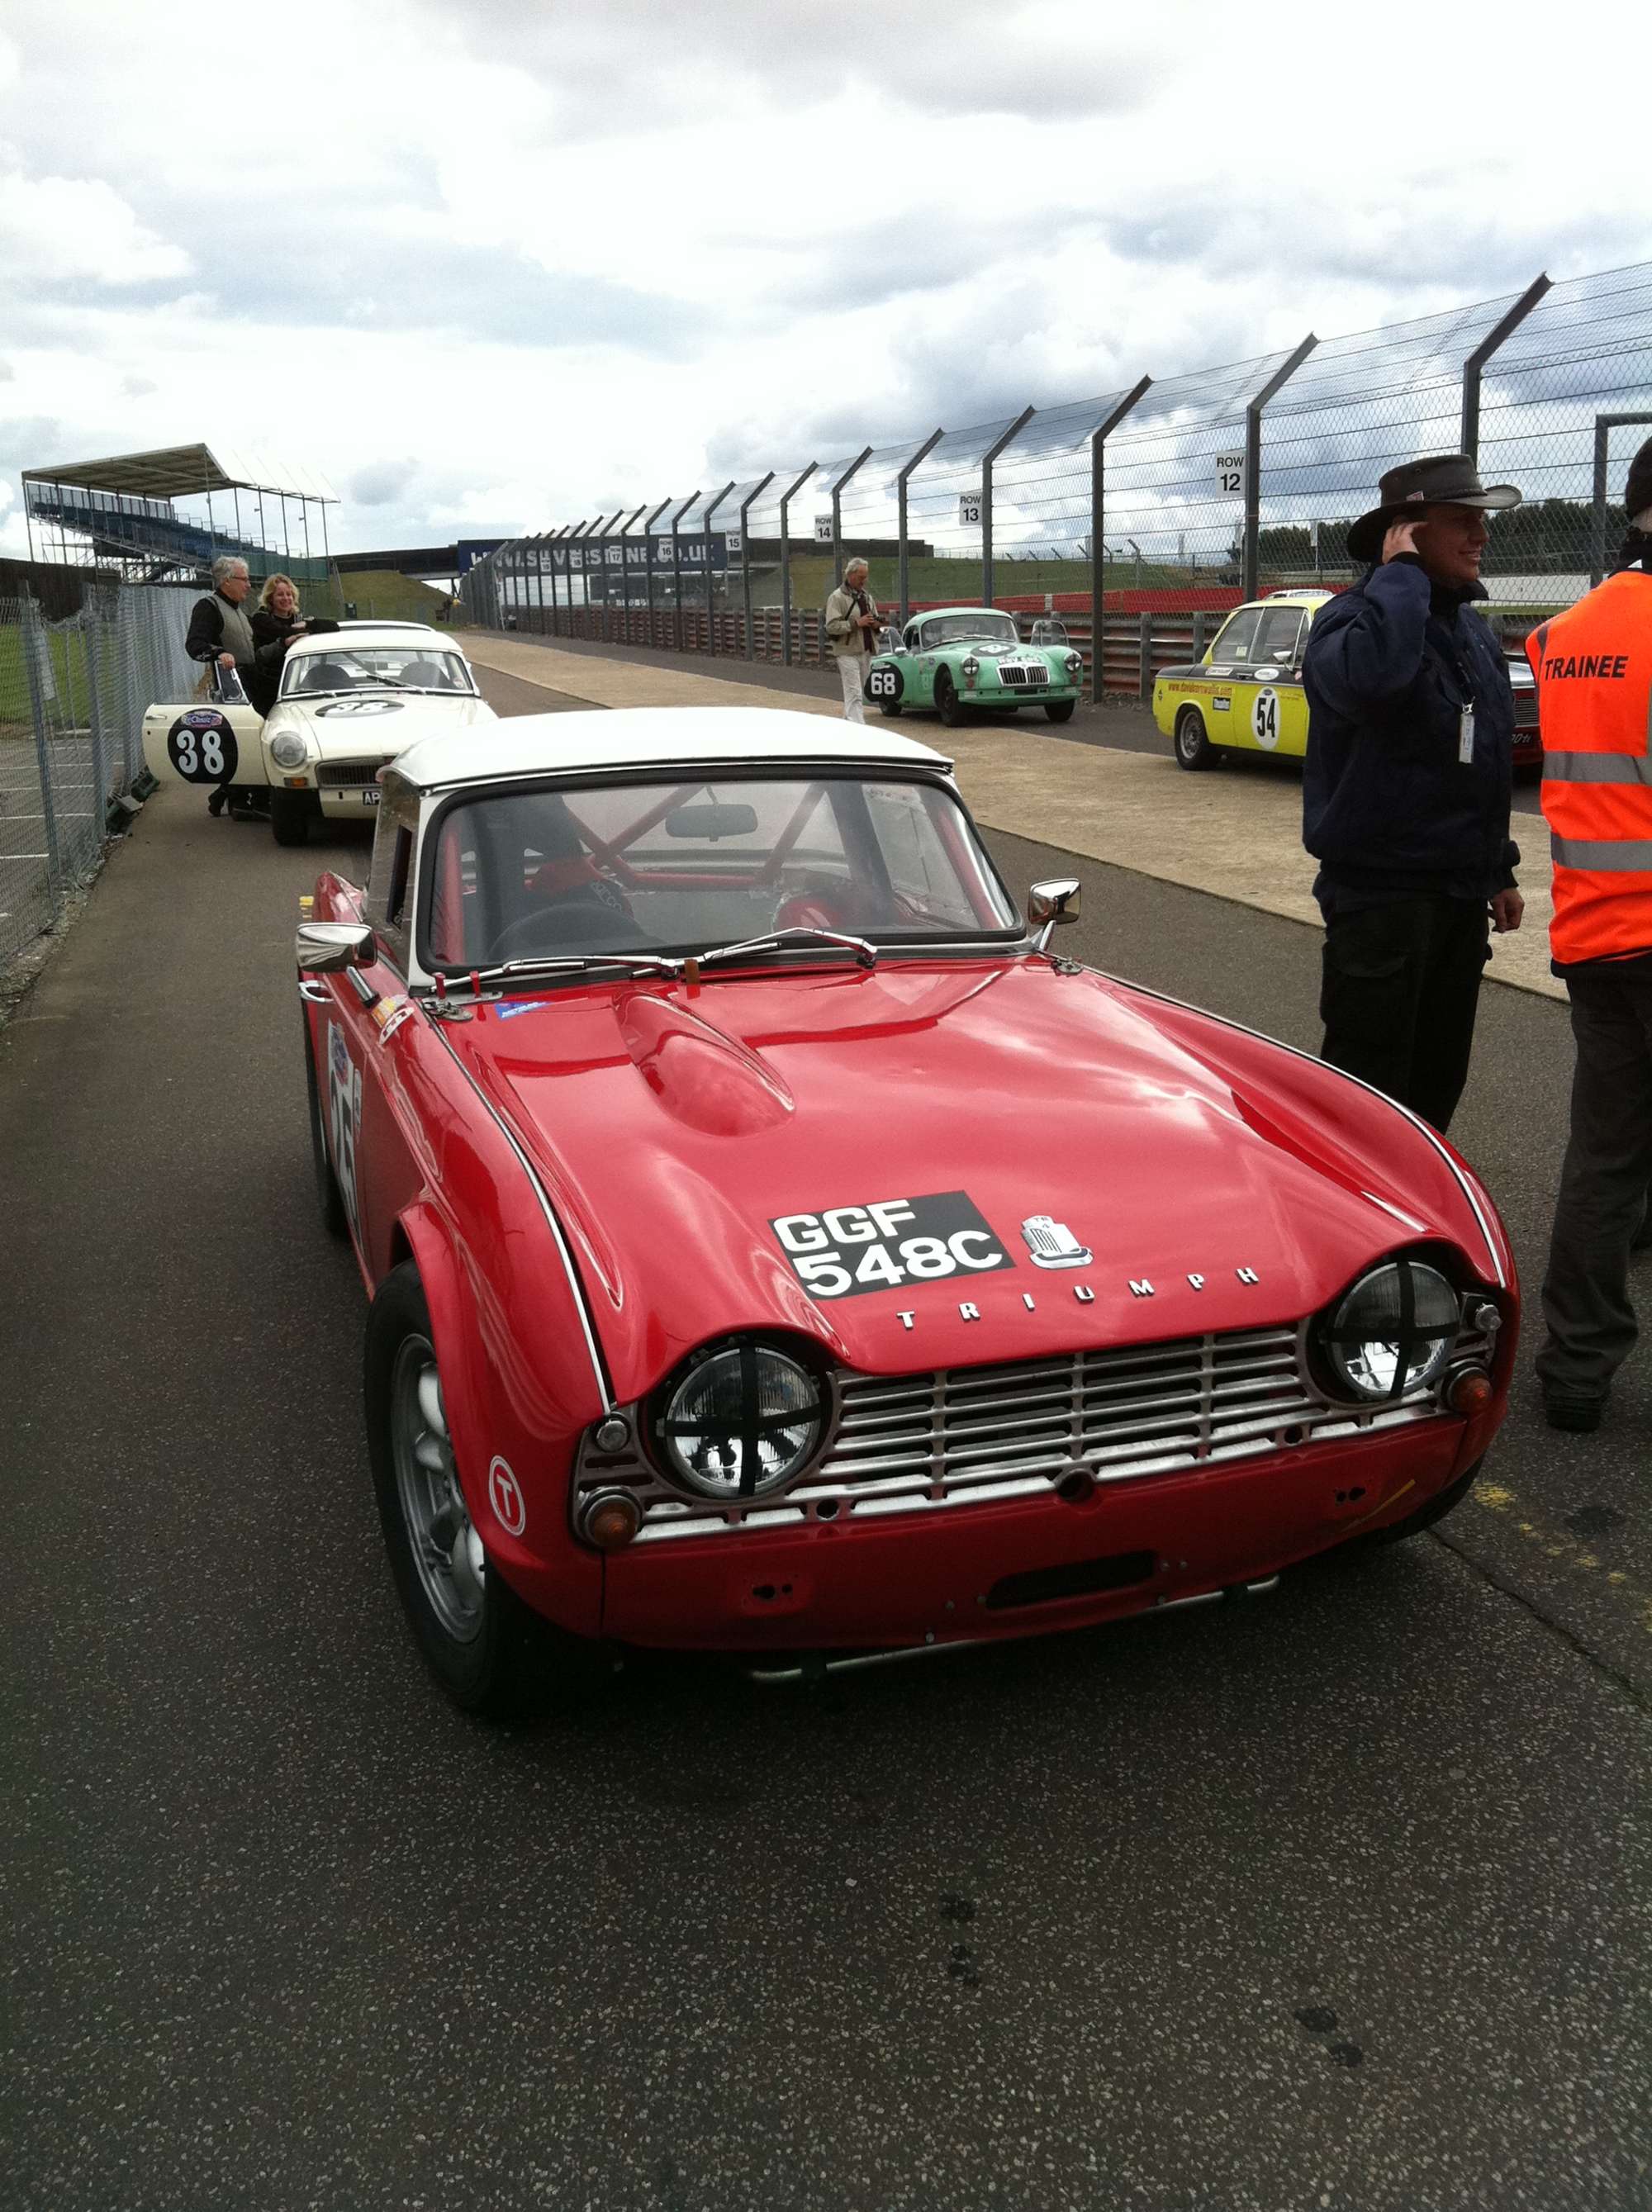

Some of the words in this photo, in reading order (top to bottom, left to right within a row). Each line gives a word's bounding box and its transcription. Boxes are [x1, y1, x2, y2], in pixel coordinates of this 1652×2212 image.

[1217, 457, 1244, 468] ROW
[1220, 473, 1241, 491] 12
[960, 496, 981, 504] ROW
[963, 508, 979, 521] 13
[729, 538, 739, 548] 15
[818, 527, 831, 538] 14
[662, 547, 672, 555] 16
[1545, 655, 1629, 681] TRAINEE
[871, 672, 895, 695] 68
[1256, 697, 1275, 738] 54
[176, 729, 225, 775] 38
[773, 1199, 917, 1253] GGF
[792, 1231, 1003, 1298] 548C
[897, 1267, 1259, 1329] TRIUMPH
[496, 1473, 513, 1518] T
